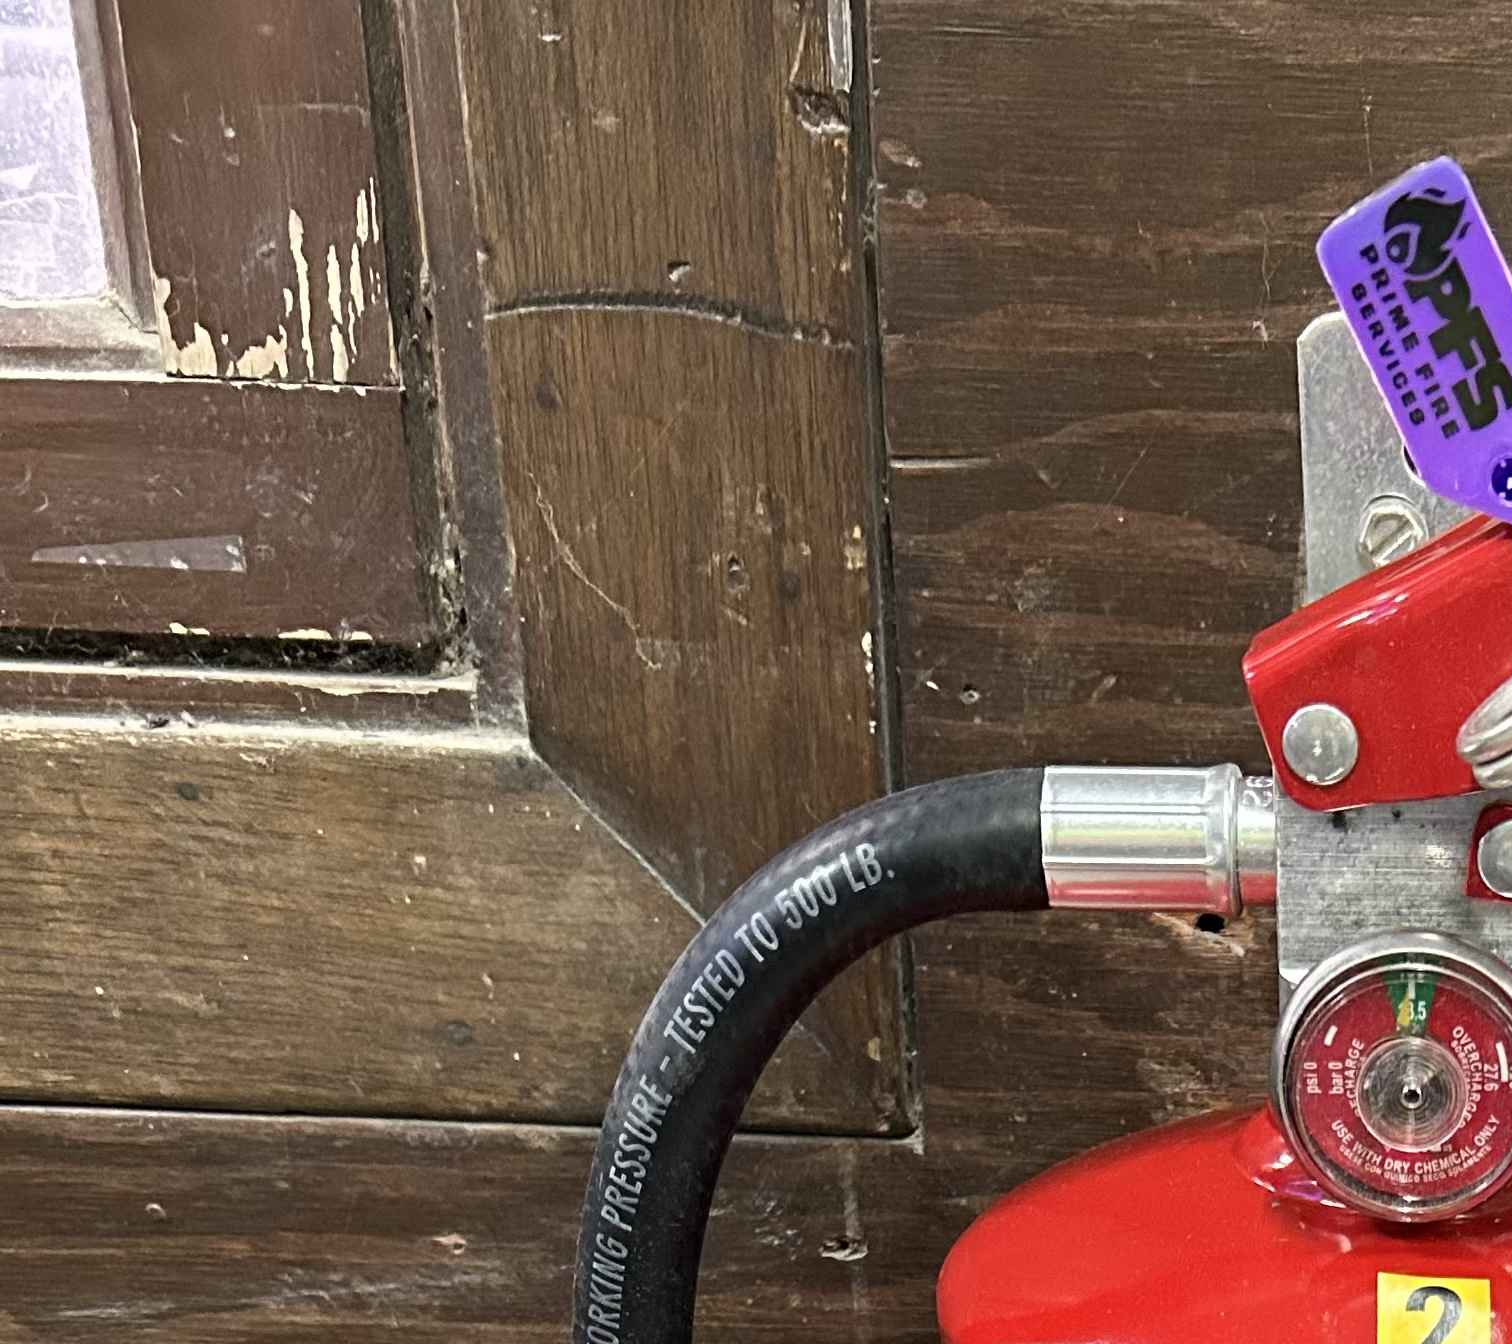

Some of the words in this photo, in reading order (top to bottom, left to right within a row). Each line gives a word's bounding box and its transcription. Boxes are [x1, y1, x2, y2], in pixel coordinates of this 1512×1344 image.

[1351, 283, 1425, 426] SERVICES
[1359, 244, 1419, 352] PRIME
[1415, 363, 1460, 439] FIRE
[601, 1074, 672, 1232] PRESSURE
[664, 949, 745, 1054] TESTED
[734, 911, 779, 962] TO
[774, 866, 838, 929] 500
[840, 843, 895, 892] LB.
[1332, 1120, 1354, 1145] USE
[1353, 1142, 1382, 1166] WITH
[1384, 1157, 1410, 1174] DRY
[1415, 1147, 1476, 1174] CHEMICAL
[1475, 1114, 1501, 1146] ONLY
